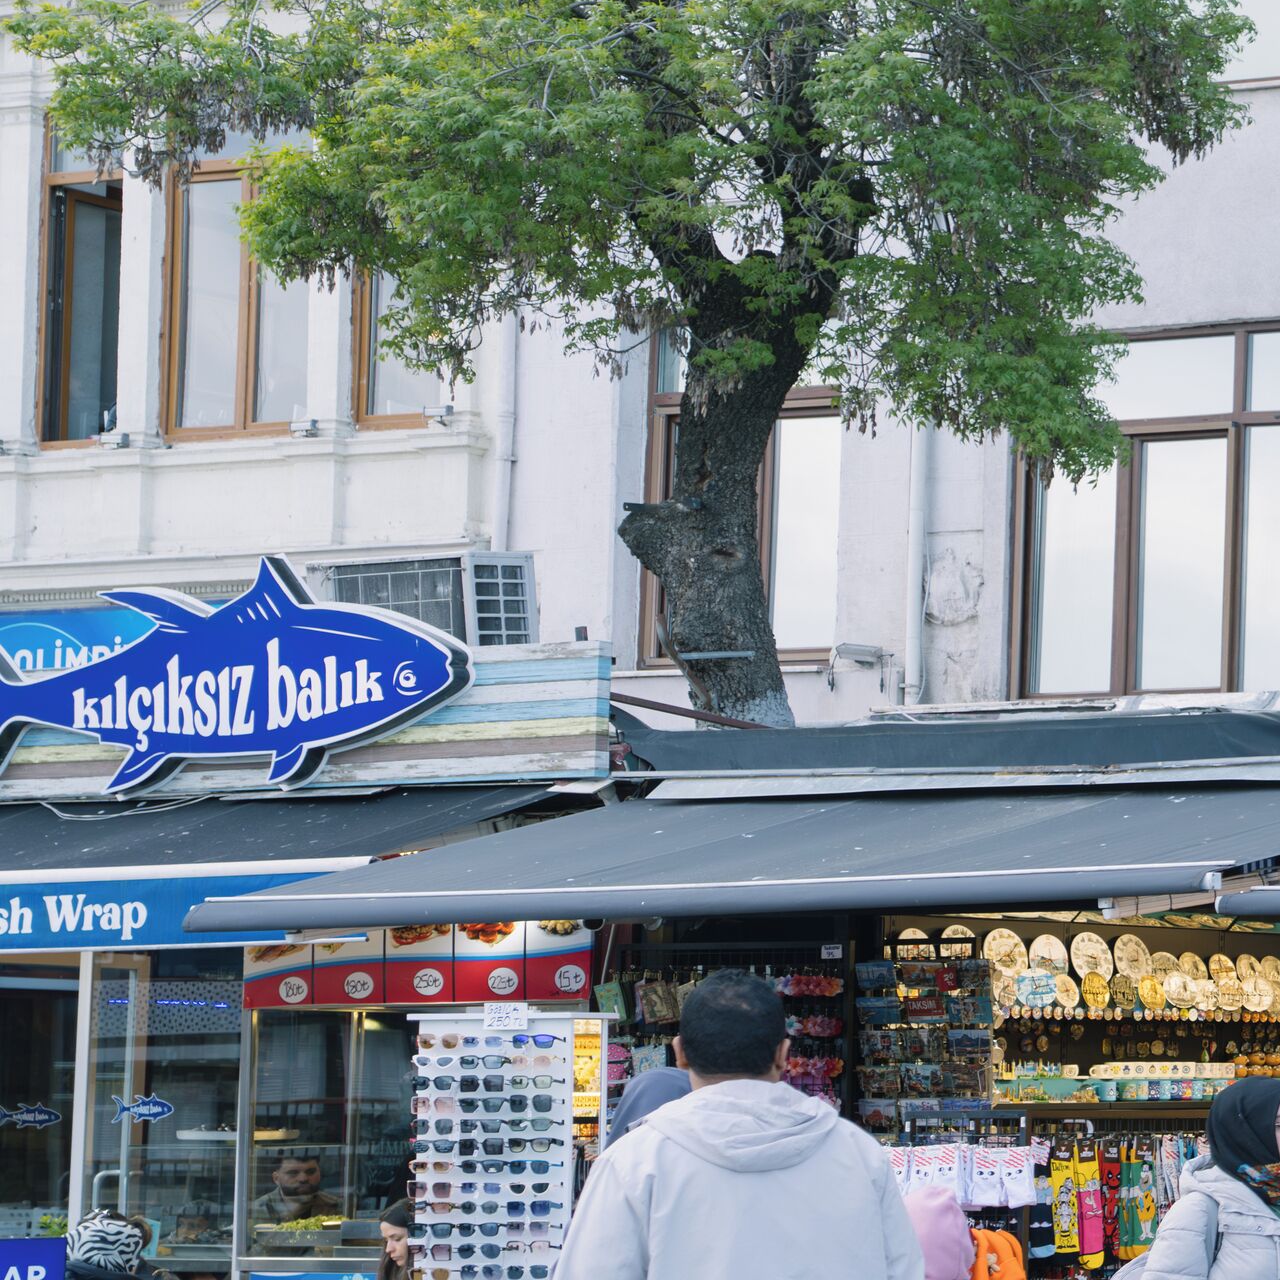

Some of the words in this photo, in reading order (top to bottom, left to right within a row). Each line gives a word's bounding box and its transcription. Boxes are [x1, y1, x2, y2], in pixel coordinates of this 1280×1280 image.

[72, 653, 255, 752] kılçıksız
[267, 637, 385, 731] balık
[42, 893, 148, 941] Wrap
